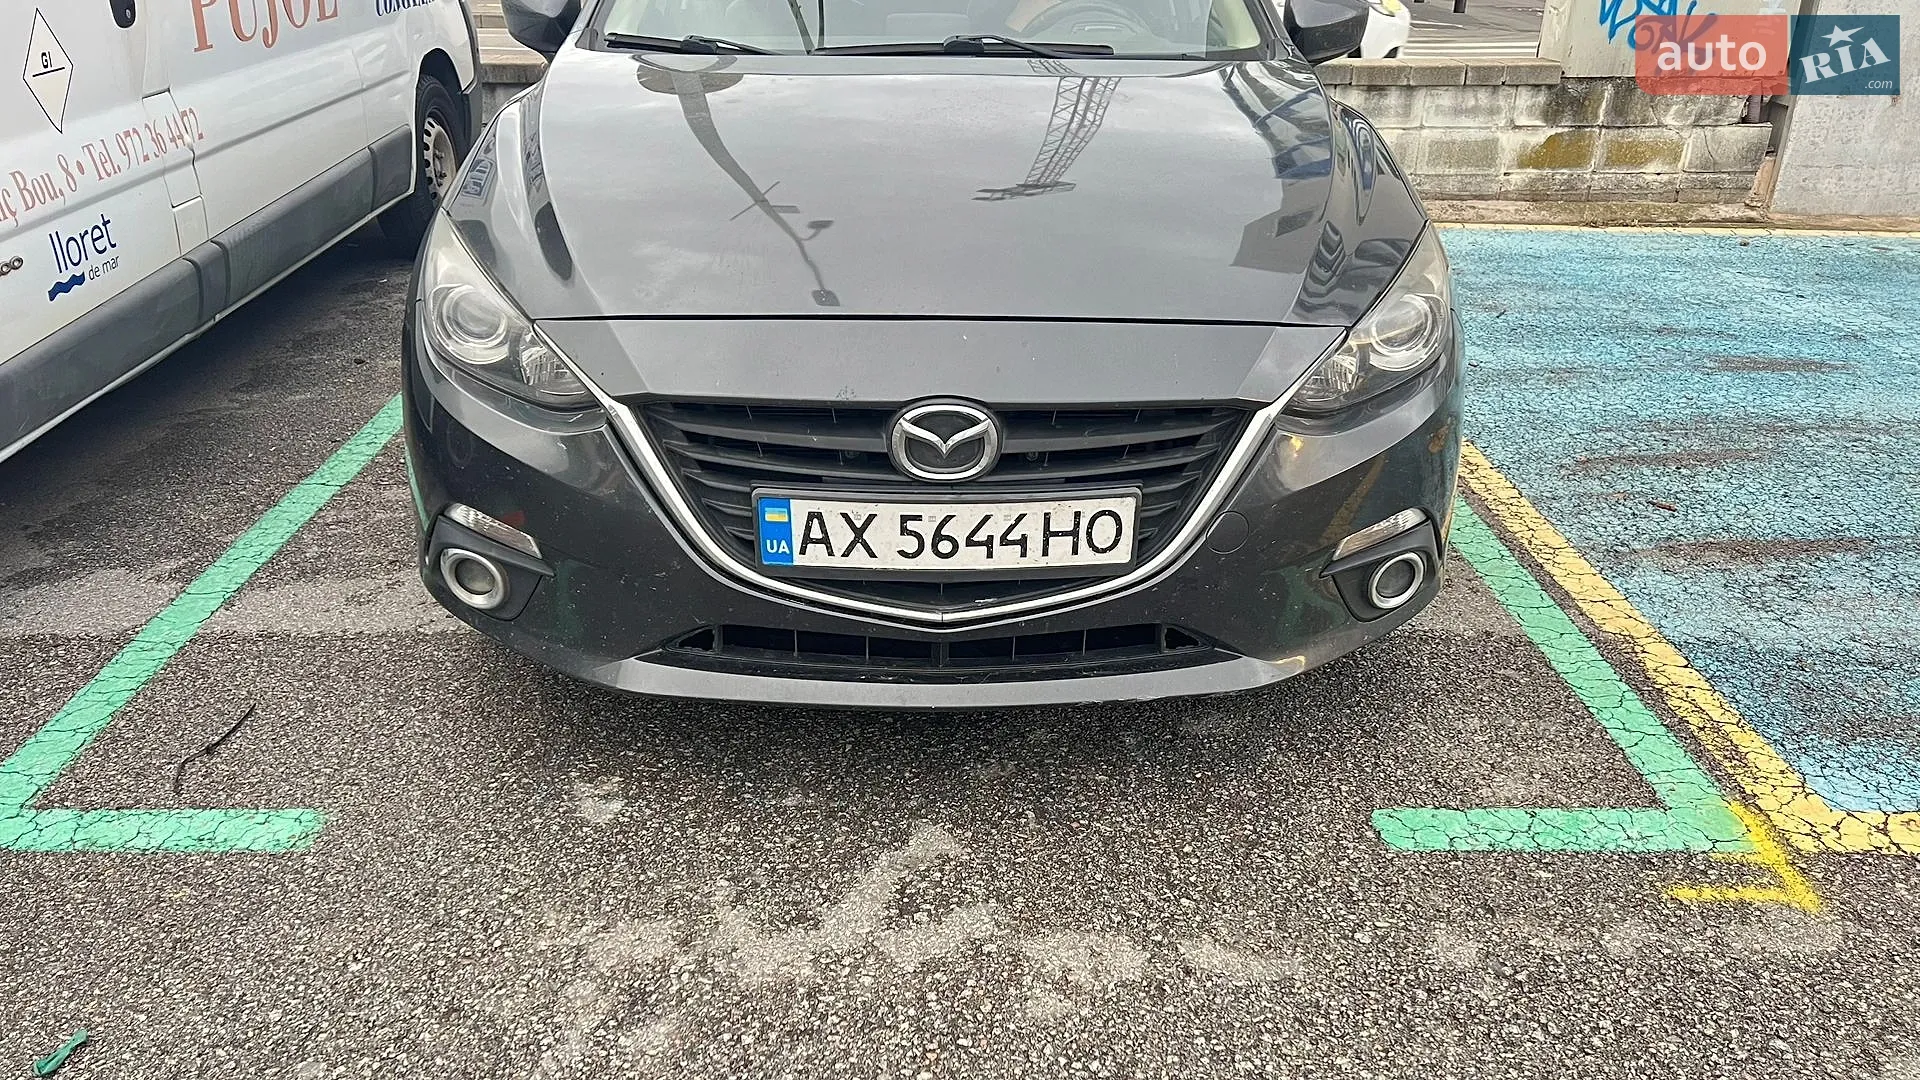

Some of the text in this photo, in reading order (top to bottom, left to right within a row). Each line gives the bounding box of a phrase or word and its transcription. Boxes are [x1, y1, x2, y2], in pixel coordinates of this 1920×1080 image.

[9, 170, 66, 205] Bou,
[57, 154, 77, 193] 8
[81, 139, 121, 181] Tel.
[115, 127, 150, 170] 972
[145, 120, 167, 158] 36
[48, 213, 117, 273] lloret
[88, 255, 119, 280] de mar
[766, 539, 790, 554] UA
[798, 509, 1123, 559] AX 5644 HO
